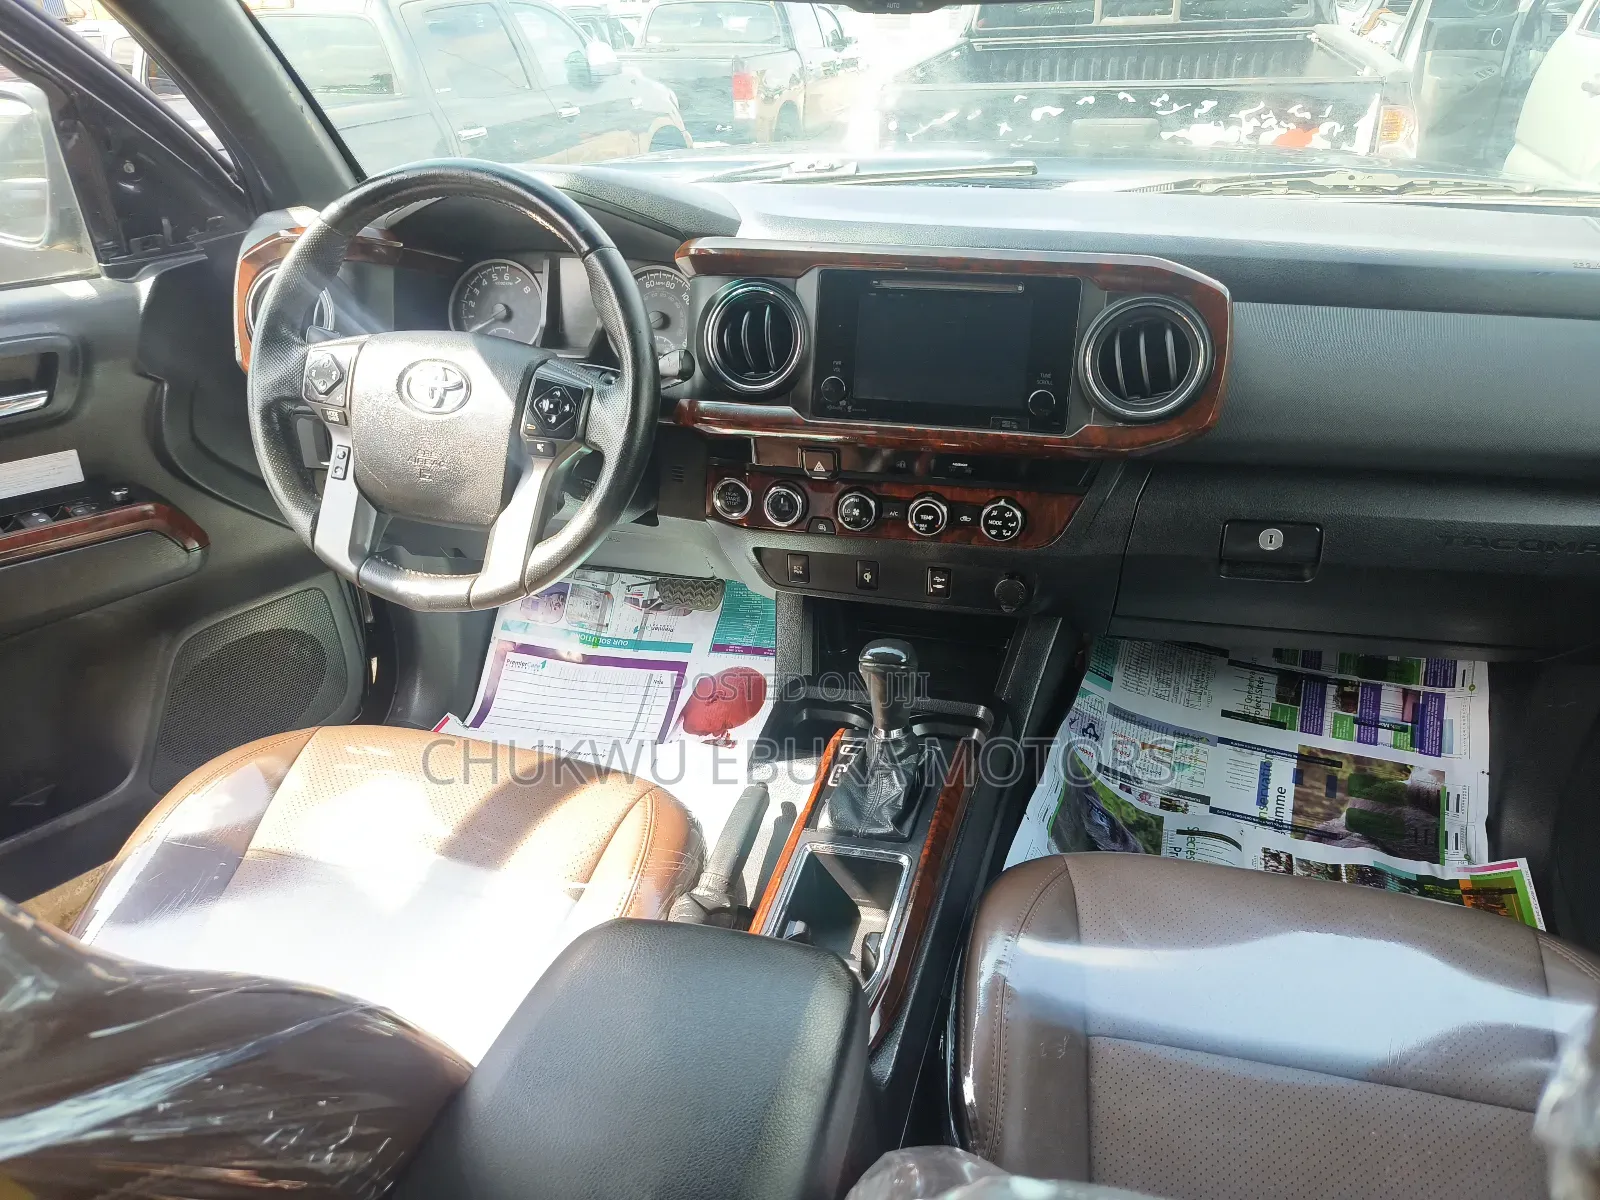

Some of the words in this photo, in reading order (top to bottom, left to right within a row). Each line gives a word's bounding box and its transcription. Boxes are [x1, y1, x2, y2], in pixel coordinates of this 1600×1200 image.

[645, 280, 655, 289] 60
[665, 280, 676, 290] 80
[1186, 826, 1200, 861] Secies
